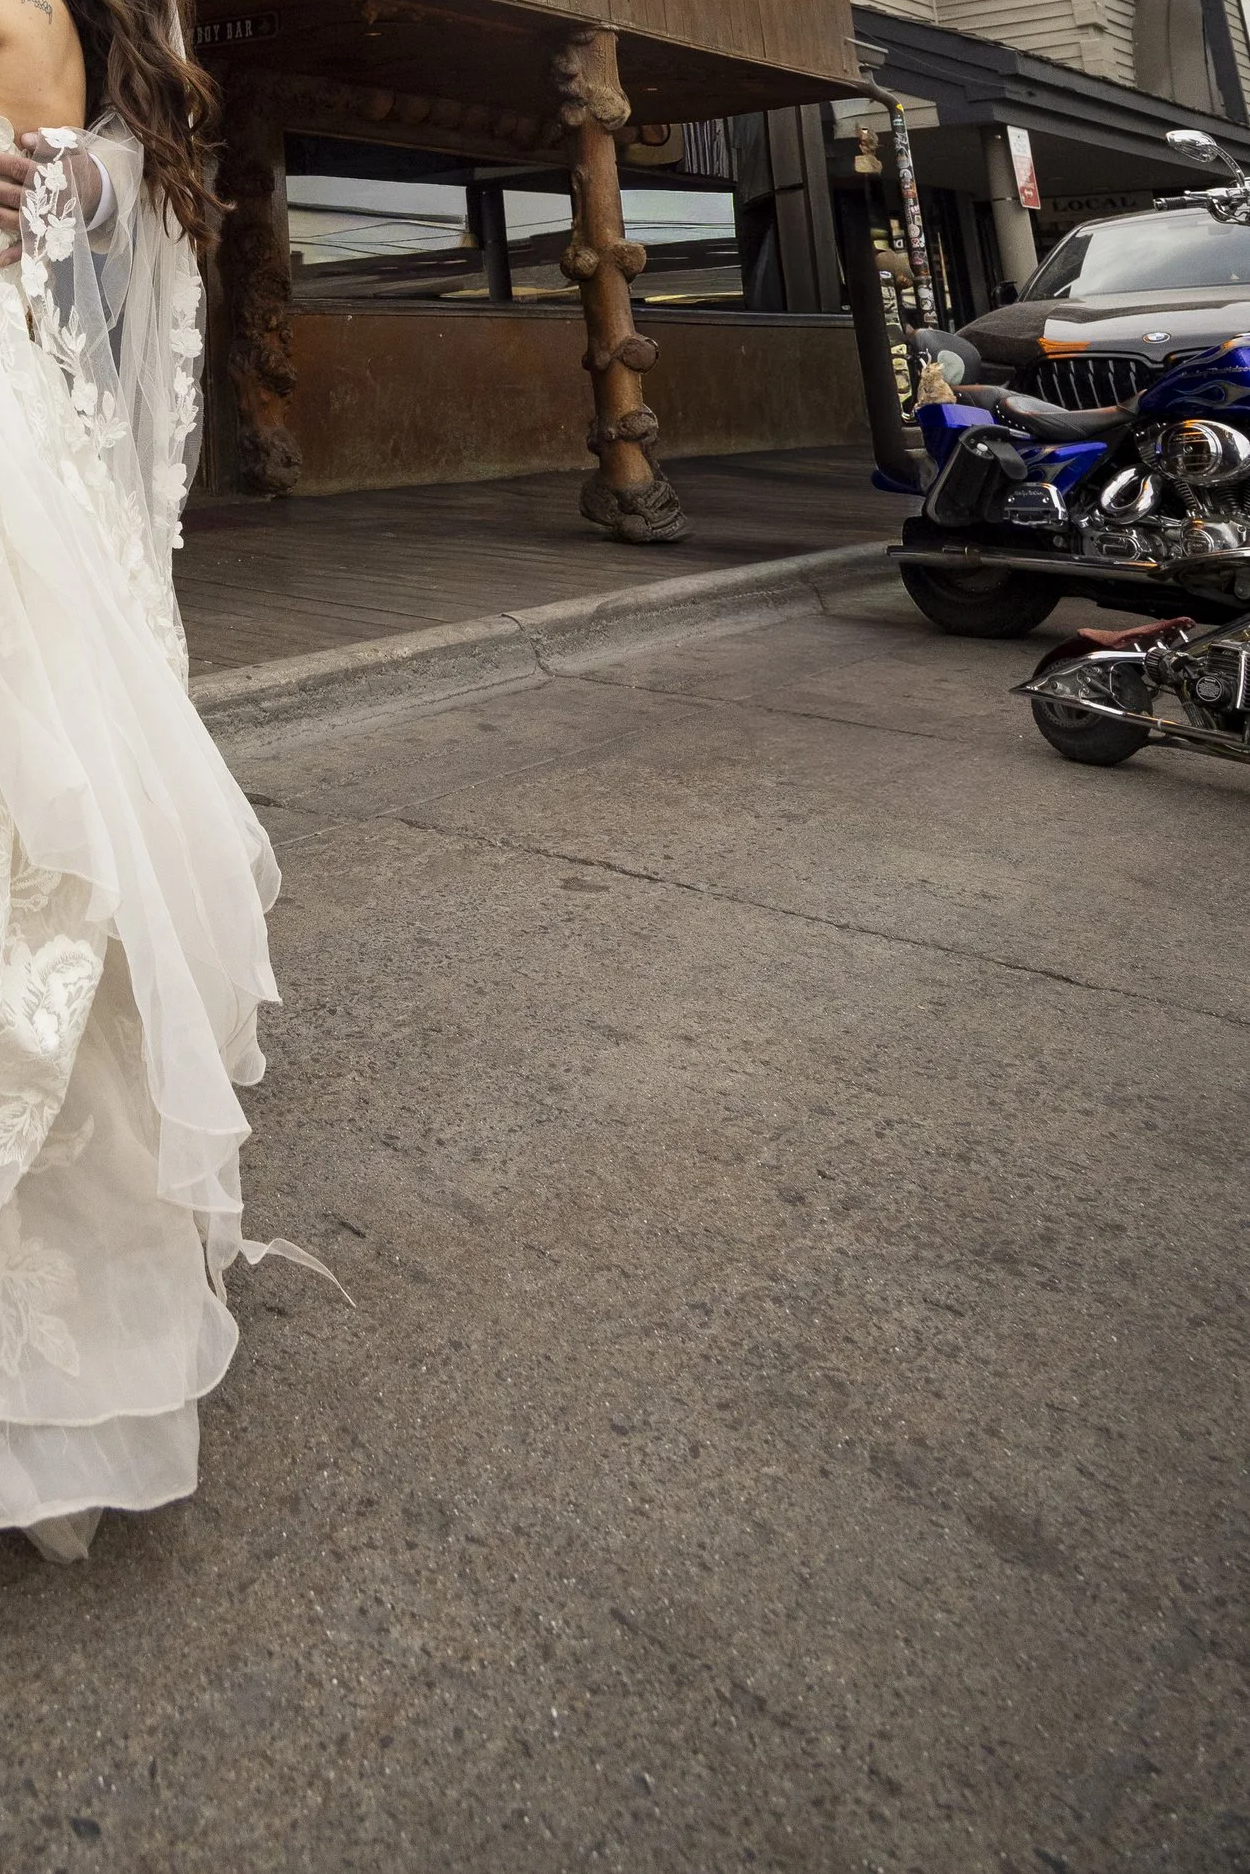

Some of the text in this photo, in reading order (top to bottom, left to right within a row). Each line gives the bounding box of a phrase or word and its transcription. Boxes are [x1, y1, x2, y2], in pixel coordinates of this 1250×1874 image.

[190, 19, 253, 45] BOY BAR
[1052, 196, 1137, 212] LOCAL
